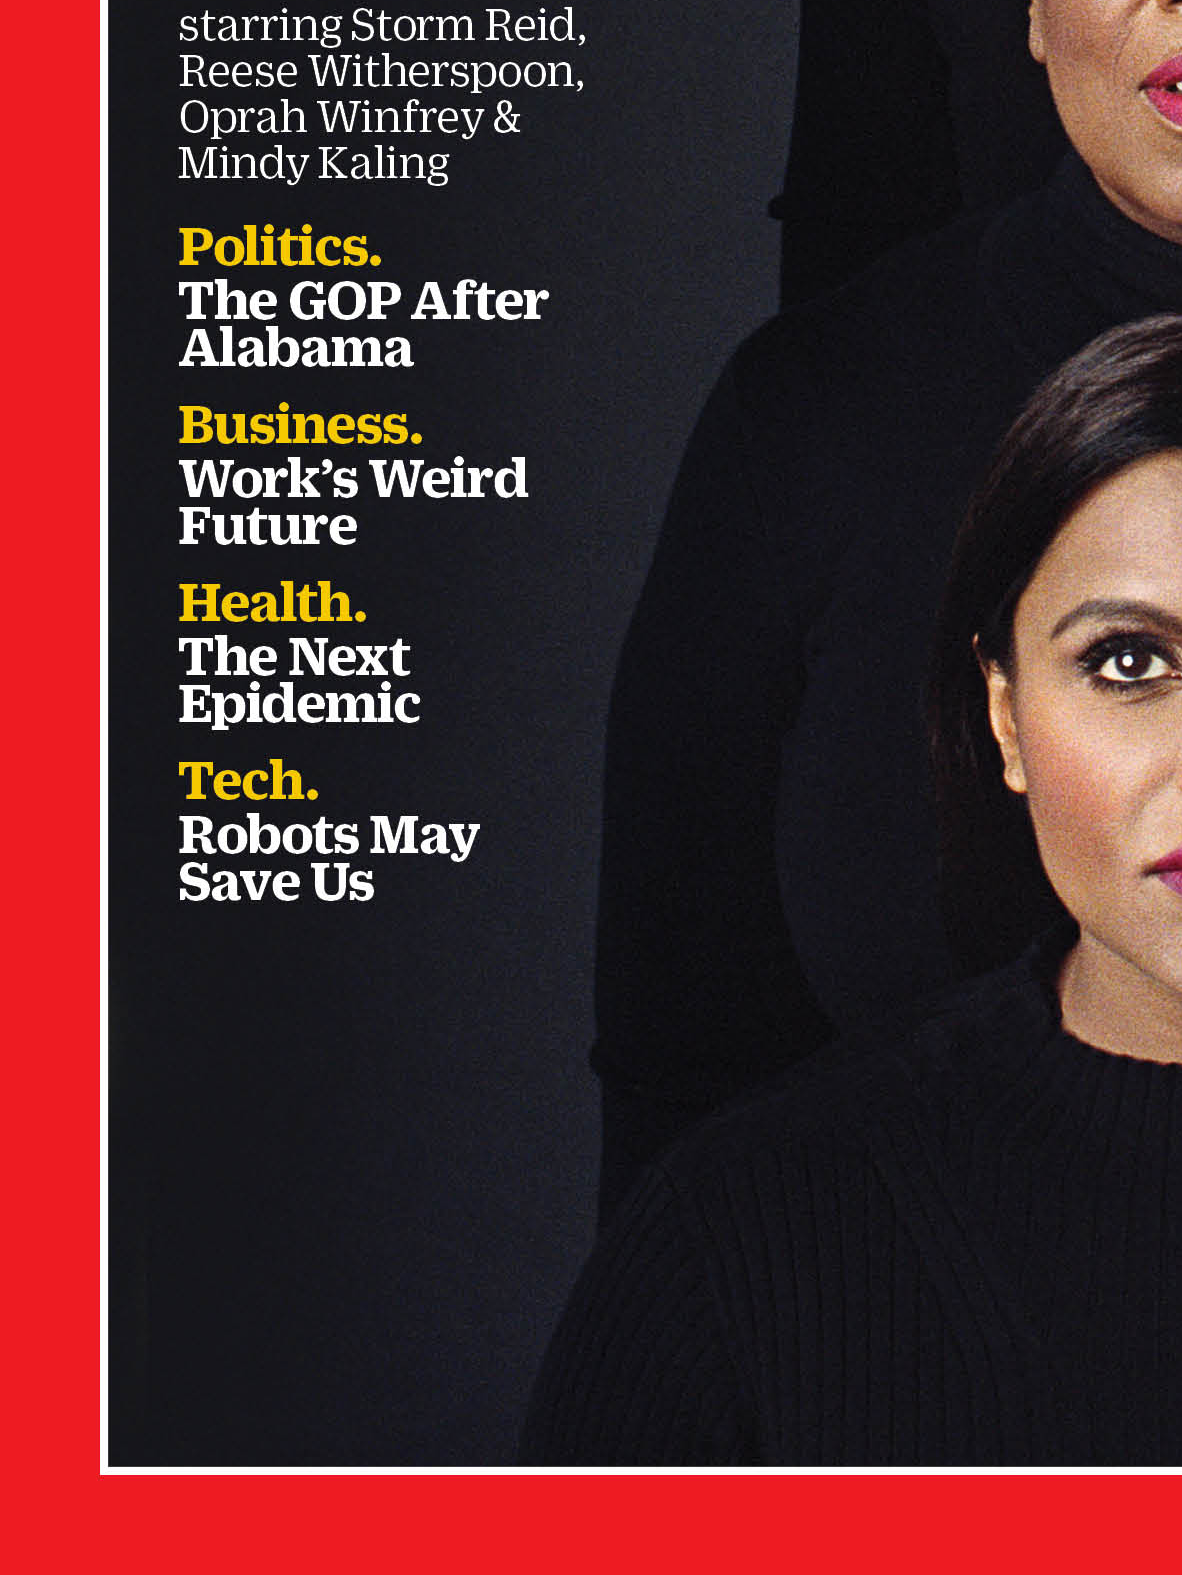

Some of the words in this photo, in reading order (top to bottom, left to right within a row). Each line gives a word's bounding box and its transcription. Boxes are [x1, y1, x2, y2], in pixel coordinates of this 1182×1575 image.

[179, 7, 343, 49] starring
[351, 7, 476, 42] Storm
[485, 6, 586, 46] Reid,
[179, 54, 298, 88] Reese
[307, 52, 584, 94] Witherspoon,
[180, 98, 308, 140] Oprah
[316, 98, 485, 140] Winfrey
[493, 99, 521, 134] &
[178, 144, 310, 186] Mindy
[318, 144, 450, 187] Kaling
[178, 223, 382, 267] Politics.
[178, 278, 278, 321] The
[289, 280, 402, 321] GOP
[410, 278, 550, 321] After
[178, 325, 415, 368] Alabama
[178, 401, 423, 445] Business.
[178, 456, 359, 499] Work’s
[368, 455, 529, 499] Weird
[178, 506, 358, 546] Future
[178, 580, 367, 623] Health.
[178, 634, 278, 677] The
[288, 637, 411, 677] Next
[178, 680, 421, 731] Epidemic
[178, 758, 319, 801] Tech.
[178, 812, 360, 855] Robots
[369, 815, 481, 863] May
[179, 861, 301, 902] Save
[310, 862, 375, 902] Us
